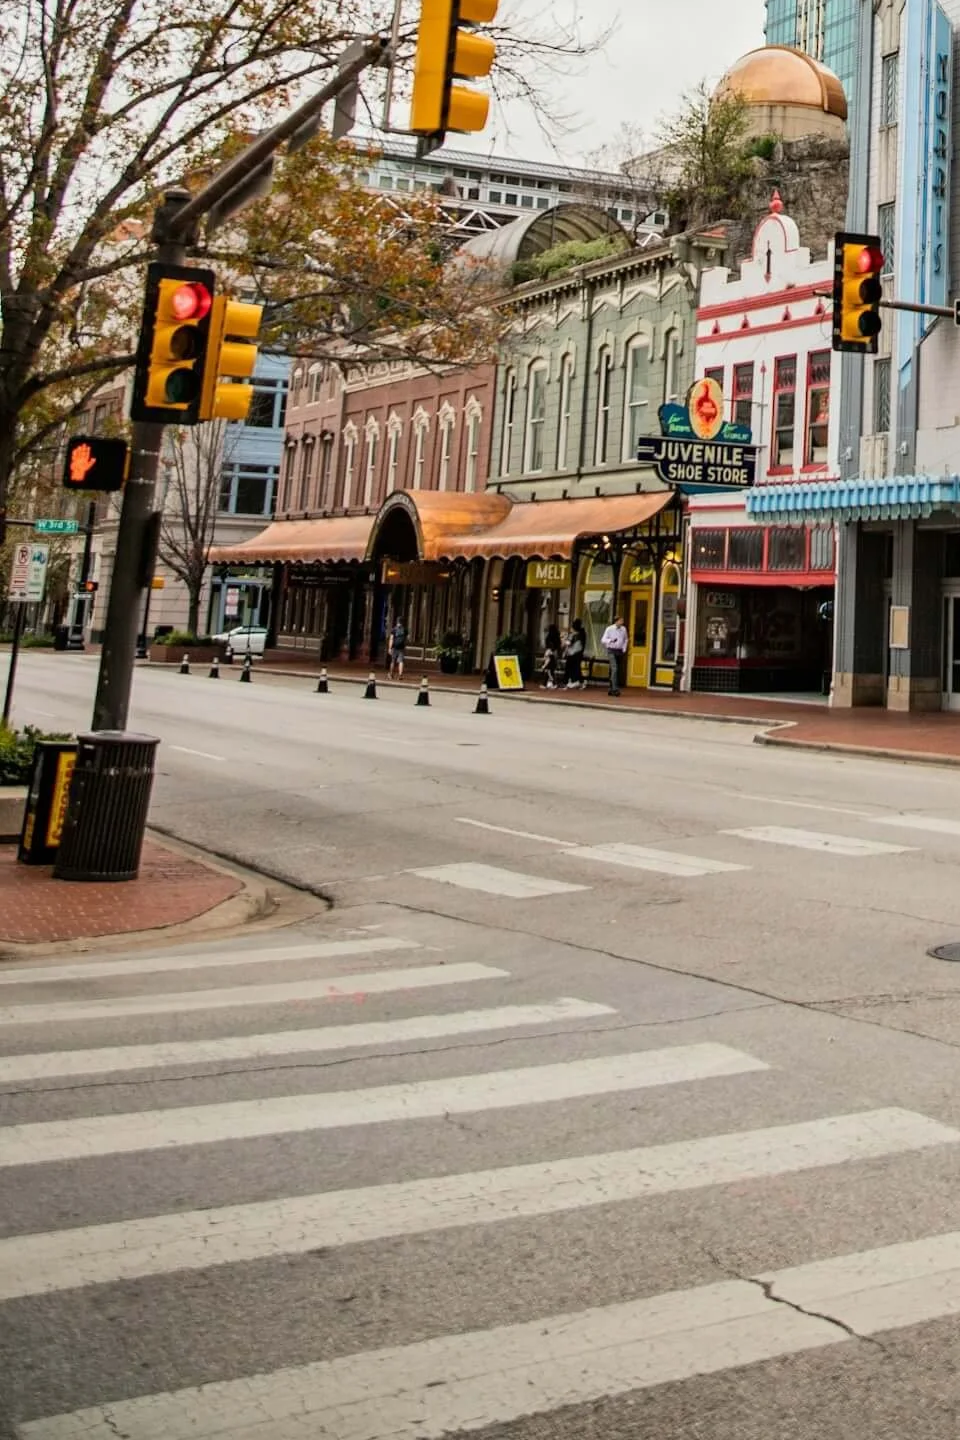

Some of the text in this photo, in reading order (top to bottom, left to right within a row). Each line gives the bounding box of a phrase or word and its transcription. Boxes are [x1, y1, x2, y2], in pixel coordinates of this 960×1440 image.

[654, 441, 744, 467] JUVENILE
[668, 463, 749, 484] SHOE STORE
[49, 521, 64, 529] 3rd
[536, 563, 569, 580] MELT
